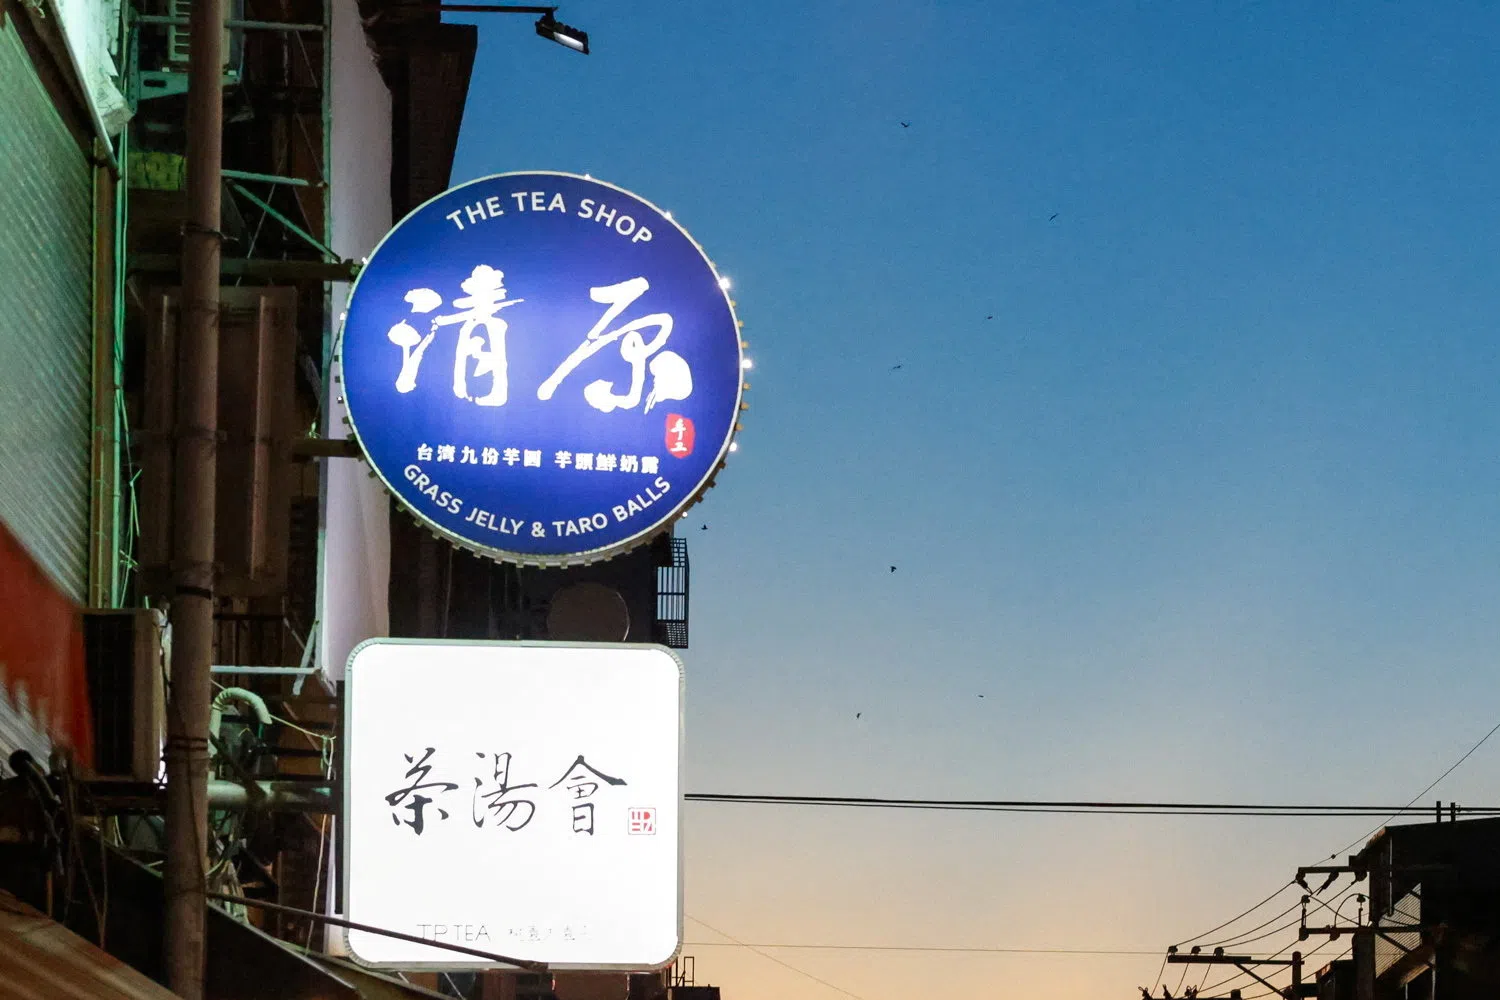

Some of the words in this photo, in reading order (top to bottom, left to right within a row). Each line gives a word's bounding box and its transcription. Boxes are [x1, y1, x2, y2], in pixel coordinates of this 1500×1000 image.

[446, 196, 505, 232] THE
[511, 191, 566, 213] TEA
[577, 198, 653, 245] SHOP
[387, 264, 693, 414] 清原
[403, 464, 464, 515] GRASS
[466, 507, 524, 536] JELLY
[531, 521, 546, 538] &
[552, 512, 608, 538] TARO
[612, 476, 671, 523] BALLS
[385, 747, 628, 836] 茶湯會
[416, 924, 448, 942] TP
[453, 924, 491, 942] TEA
